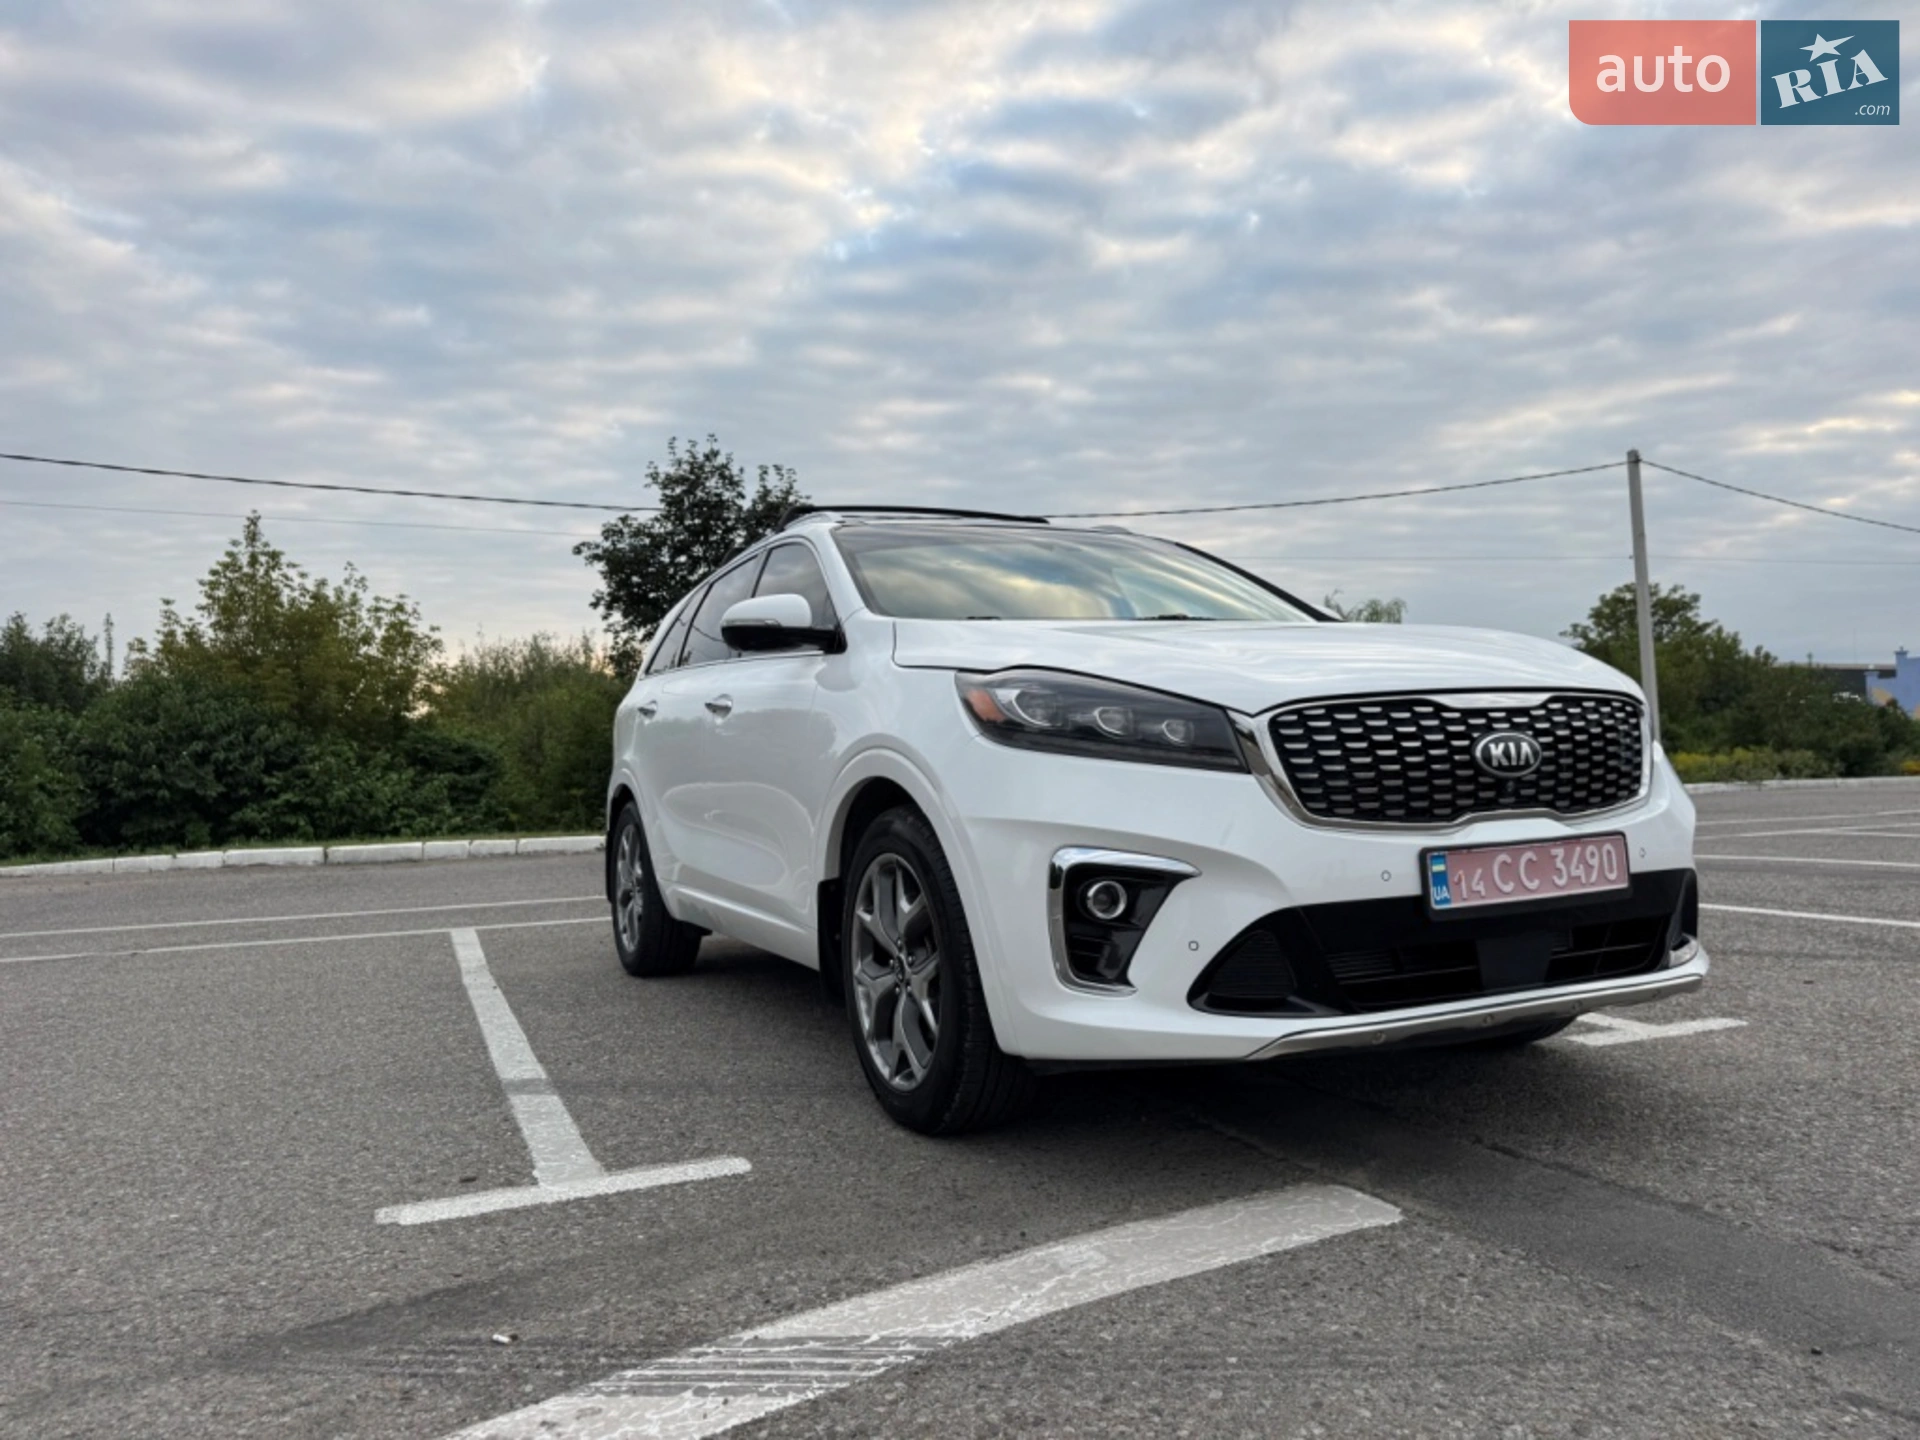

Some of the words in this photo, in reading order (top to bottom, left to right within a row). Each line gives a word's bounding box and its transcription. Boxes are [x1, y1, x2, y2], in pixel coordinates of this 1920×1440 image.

[1488, 741, 1535, 767] KIA
[1453, 868, 1486, 900] 14
[1492, 850, 1541, 893] CC
[1552, 843, 1618, 887] 3490
[1433, 886, 1450, 901] UA
